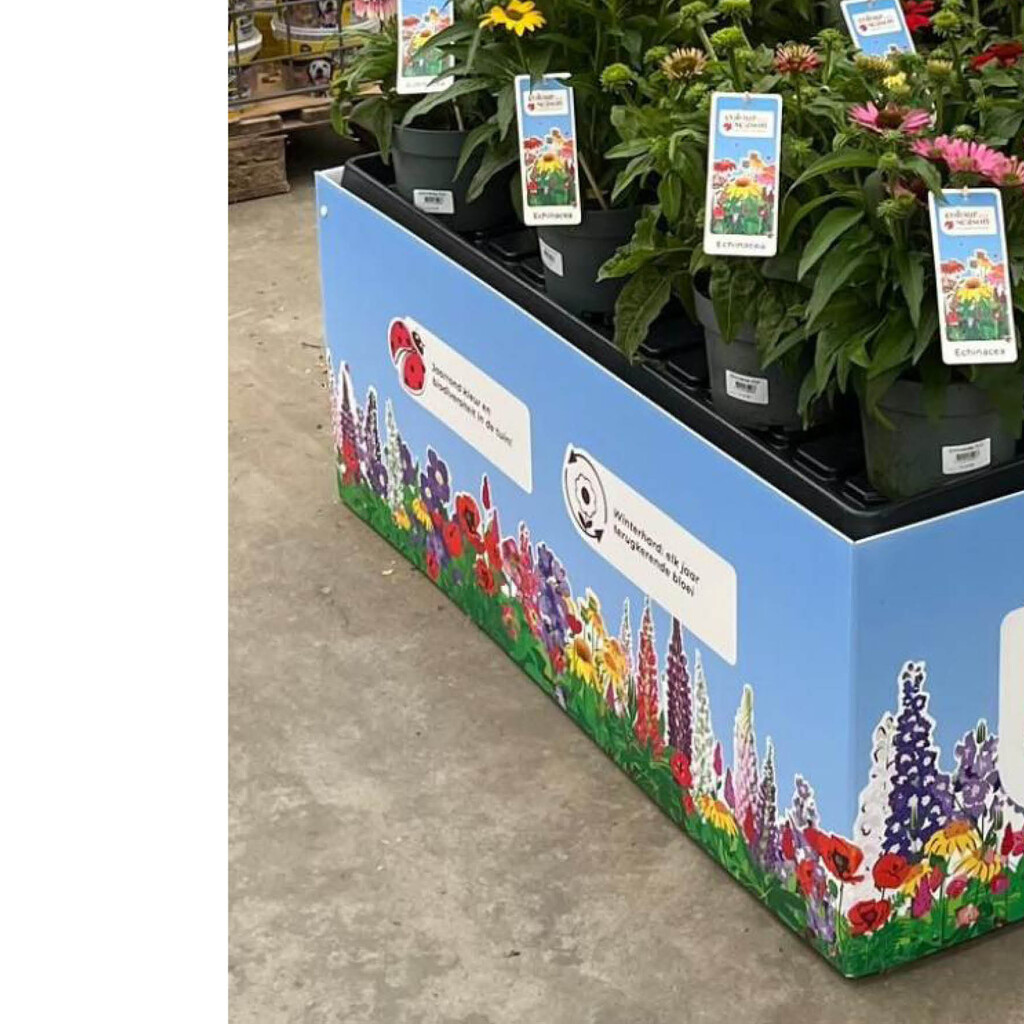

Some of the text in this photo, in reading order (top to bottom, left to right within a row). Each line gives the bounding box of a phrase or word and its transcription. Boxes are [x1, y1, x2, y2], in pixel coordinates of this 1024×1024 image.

[954, 347, 1006, 357] Echinacea
[613, 524, 694, 597] terugkerende bloei
[666, 552, 680, 568] elk
[680, 561, 700, 584] jaar
